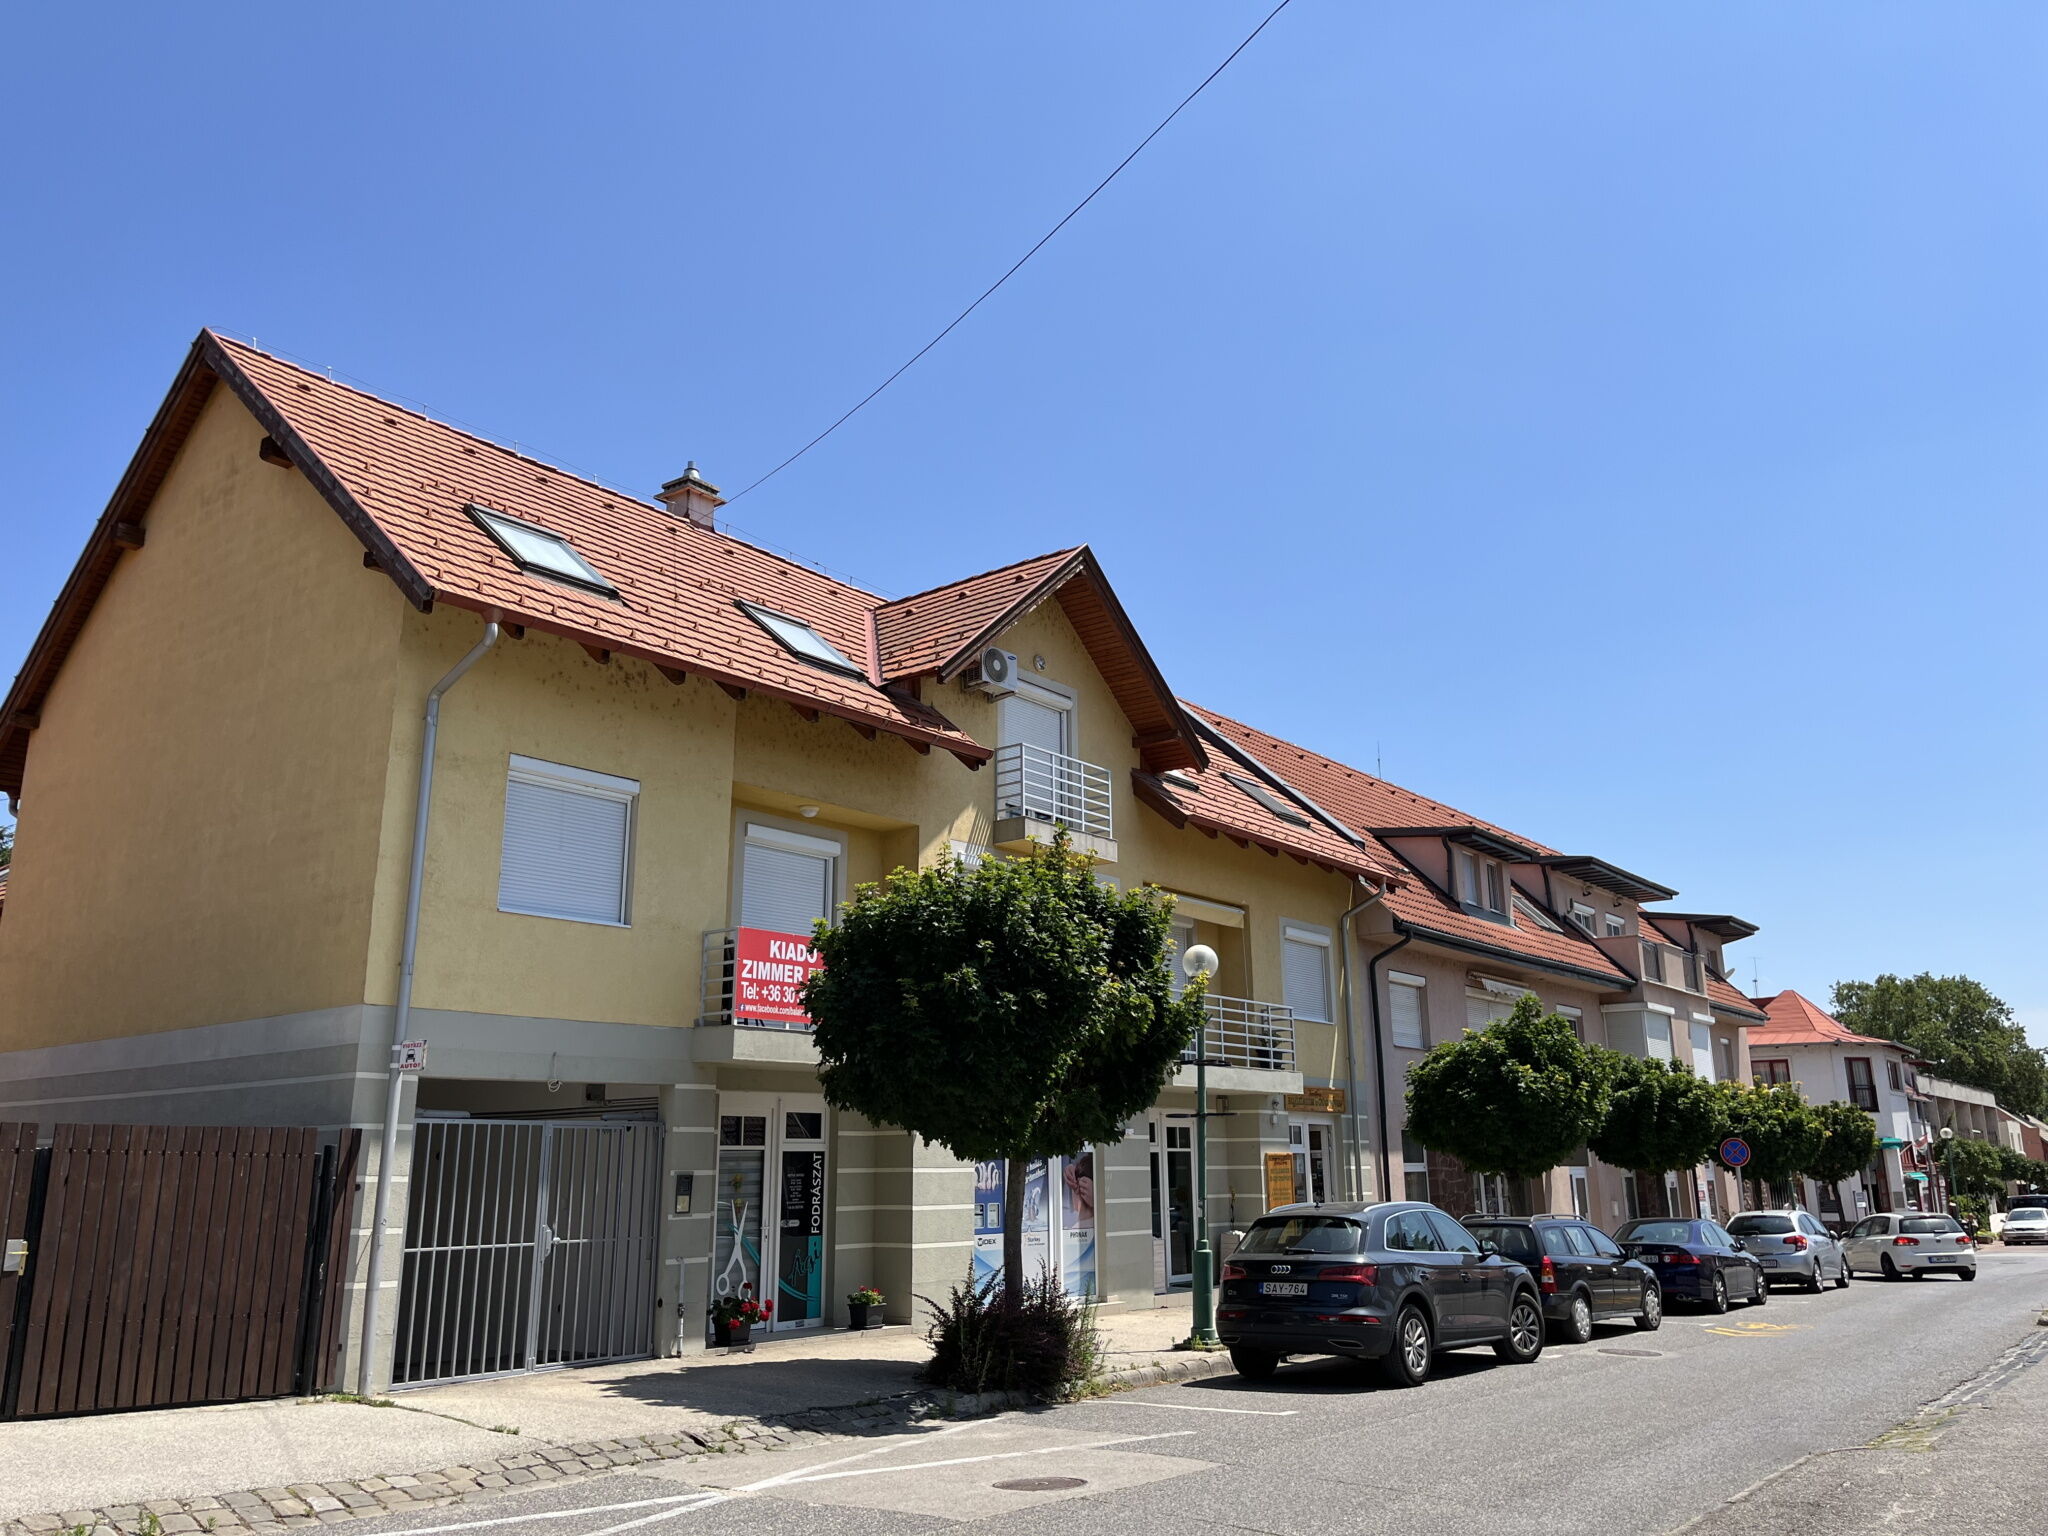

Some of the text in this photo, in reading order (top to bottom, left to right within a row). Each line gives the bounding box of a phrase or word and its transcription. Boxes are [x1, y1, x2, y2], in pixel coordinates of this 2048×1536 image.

[741, 959, 804, 984] ZIMMER
[741, 981, 759, 1000] Tel:
[761, 984, 781, 1002] +36
[783, 986, 796, 1004] 30
[810, 1152, 823, 1234] FODRÁSZAT
[1264, 1283, 1306, 1294] SAY-764
